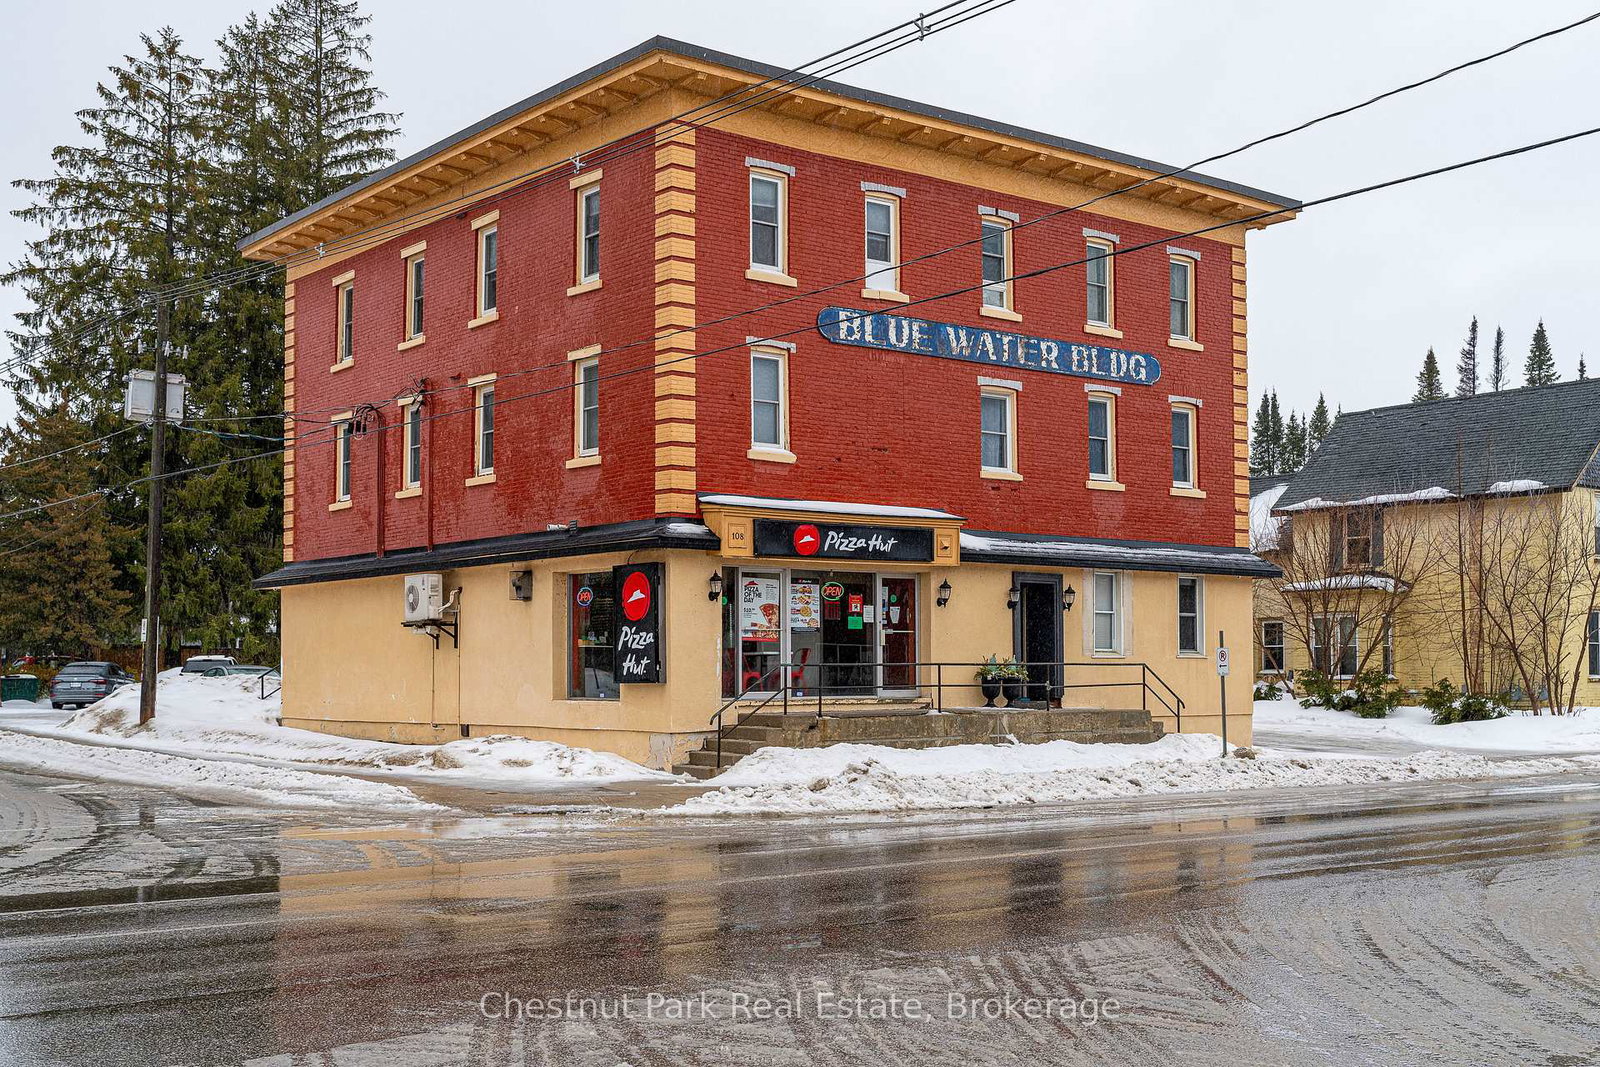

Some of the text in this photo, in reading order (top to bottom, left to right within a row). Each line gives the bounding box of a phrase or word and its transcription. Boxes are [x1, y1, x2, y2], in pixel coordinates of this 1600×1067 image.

[839, 311, 1147, 381] BLUE WATER BLDG
[732, 532, 744, 540] 108
[824, 530, 899, 553] Pizza Hut
[824, 586, 842, 597] OPEN
[618, 626, 654, 651] Pizza
